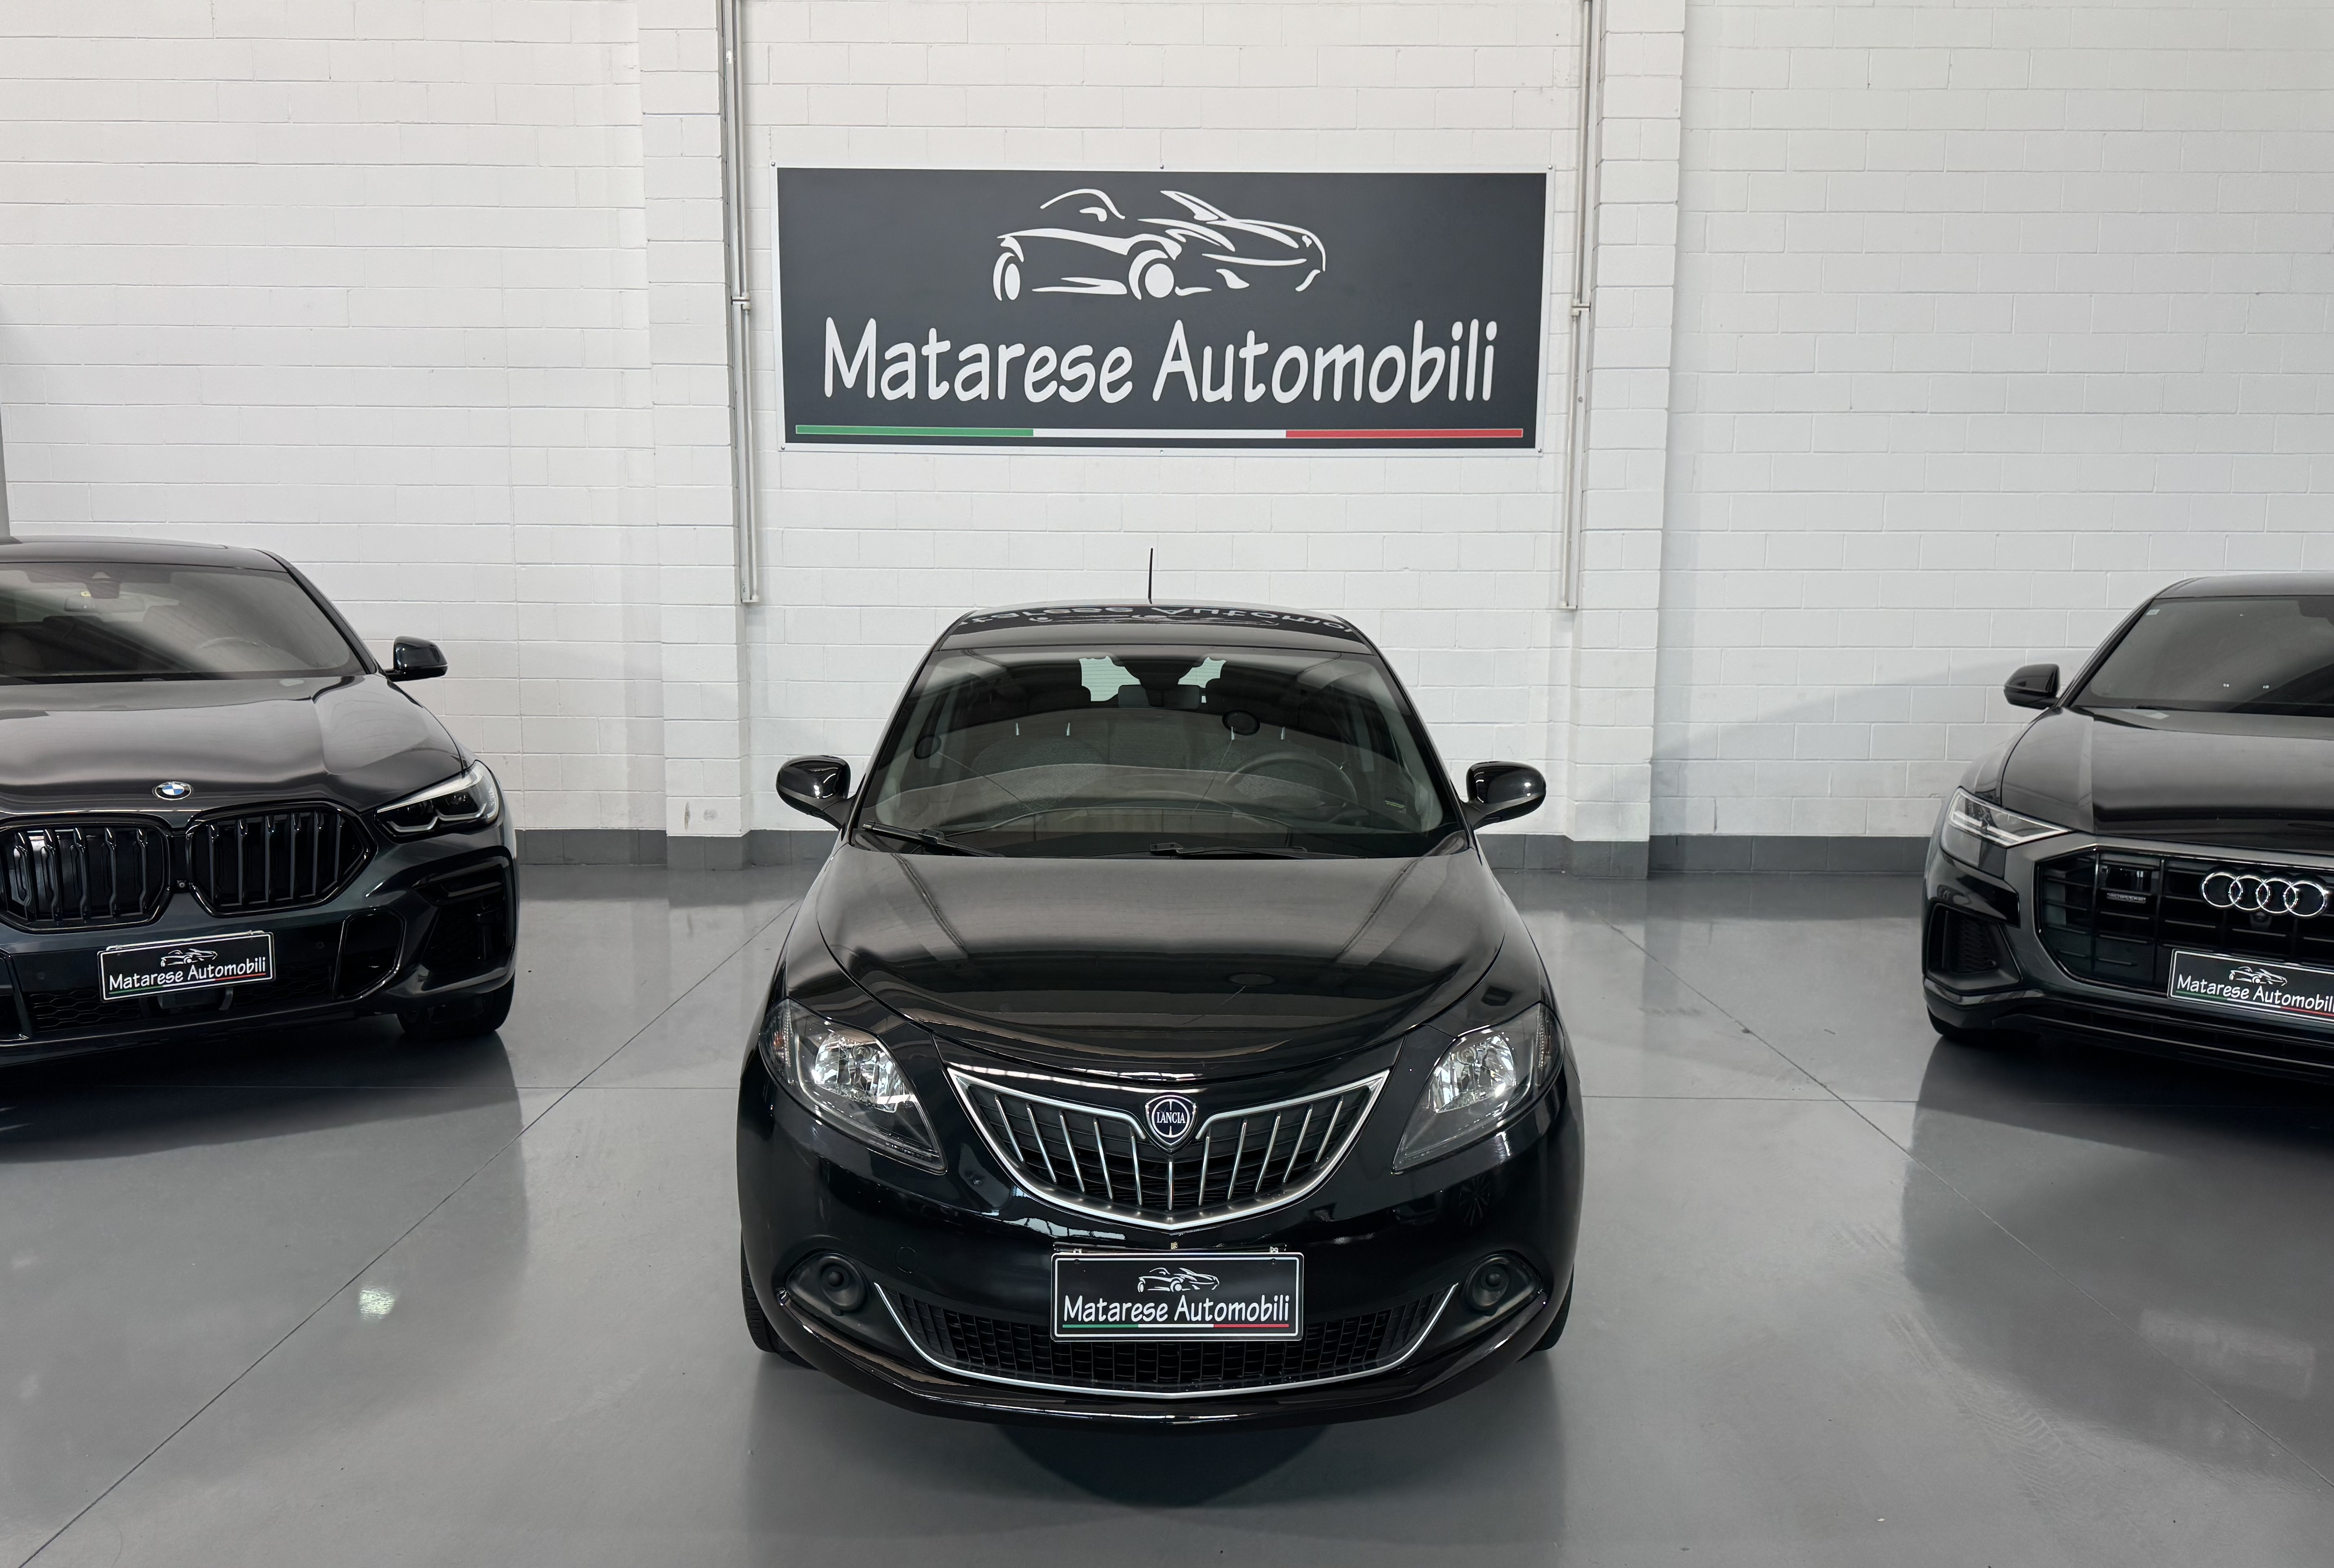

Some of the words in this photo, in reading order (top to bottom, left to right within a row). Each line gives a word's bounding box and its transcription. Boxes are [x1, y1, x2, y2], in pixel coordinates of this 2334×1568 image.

[824, 317, 1133, 403] Matarese
[1152, 319, 1497, 404] Automobili
[109, 971, 183, 991] Matarese
[188, 956, 266, 981] Automobili
[2177, 974, 2249, 999] Matarese
[1157, 1112, 1186, 1124] LANCIA
[1064, 1295, 1168, 1322] Matarese
[1174, 1294, 1290, 1322] Automobili
